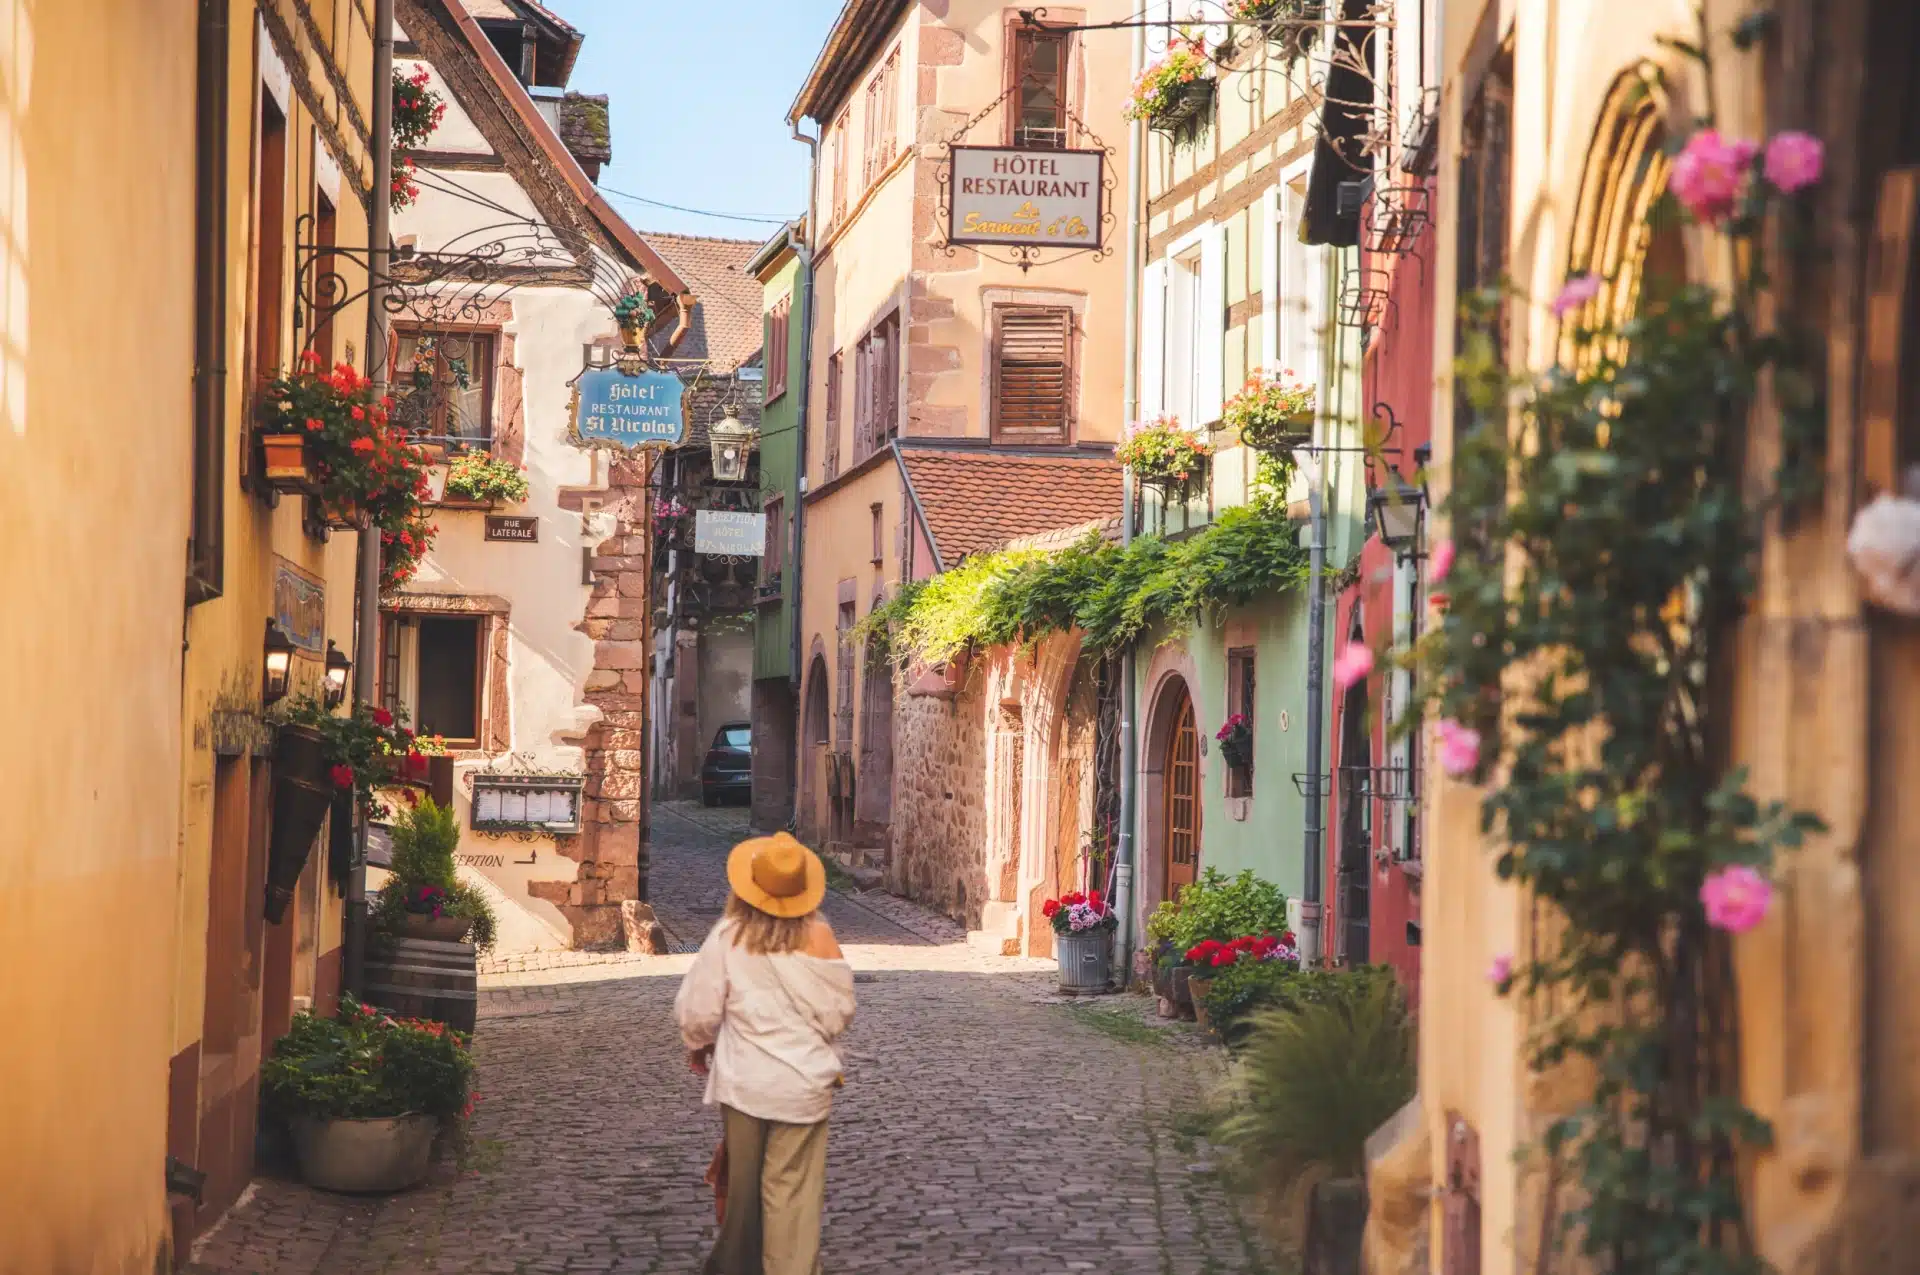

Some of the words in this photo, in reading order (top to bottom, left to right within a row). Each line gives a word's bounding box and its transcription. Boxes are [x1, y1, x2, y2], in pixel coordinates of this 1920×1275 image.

[993, 155, 1060, 176] HÔTEL
[962, 178, 1090, 198] RESTAURANT
[1013, 200, 1040, 218] Le
[962, 211, 1041, 236] Sarment
[591, 403, 670, 417] RESTAURANT
[585, 416, 605, 435] St
[611, 417, 676, 436] Nicolas
[492, 528, 532, 538] LATERALE
[504, 520, 520, 528] RUE
